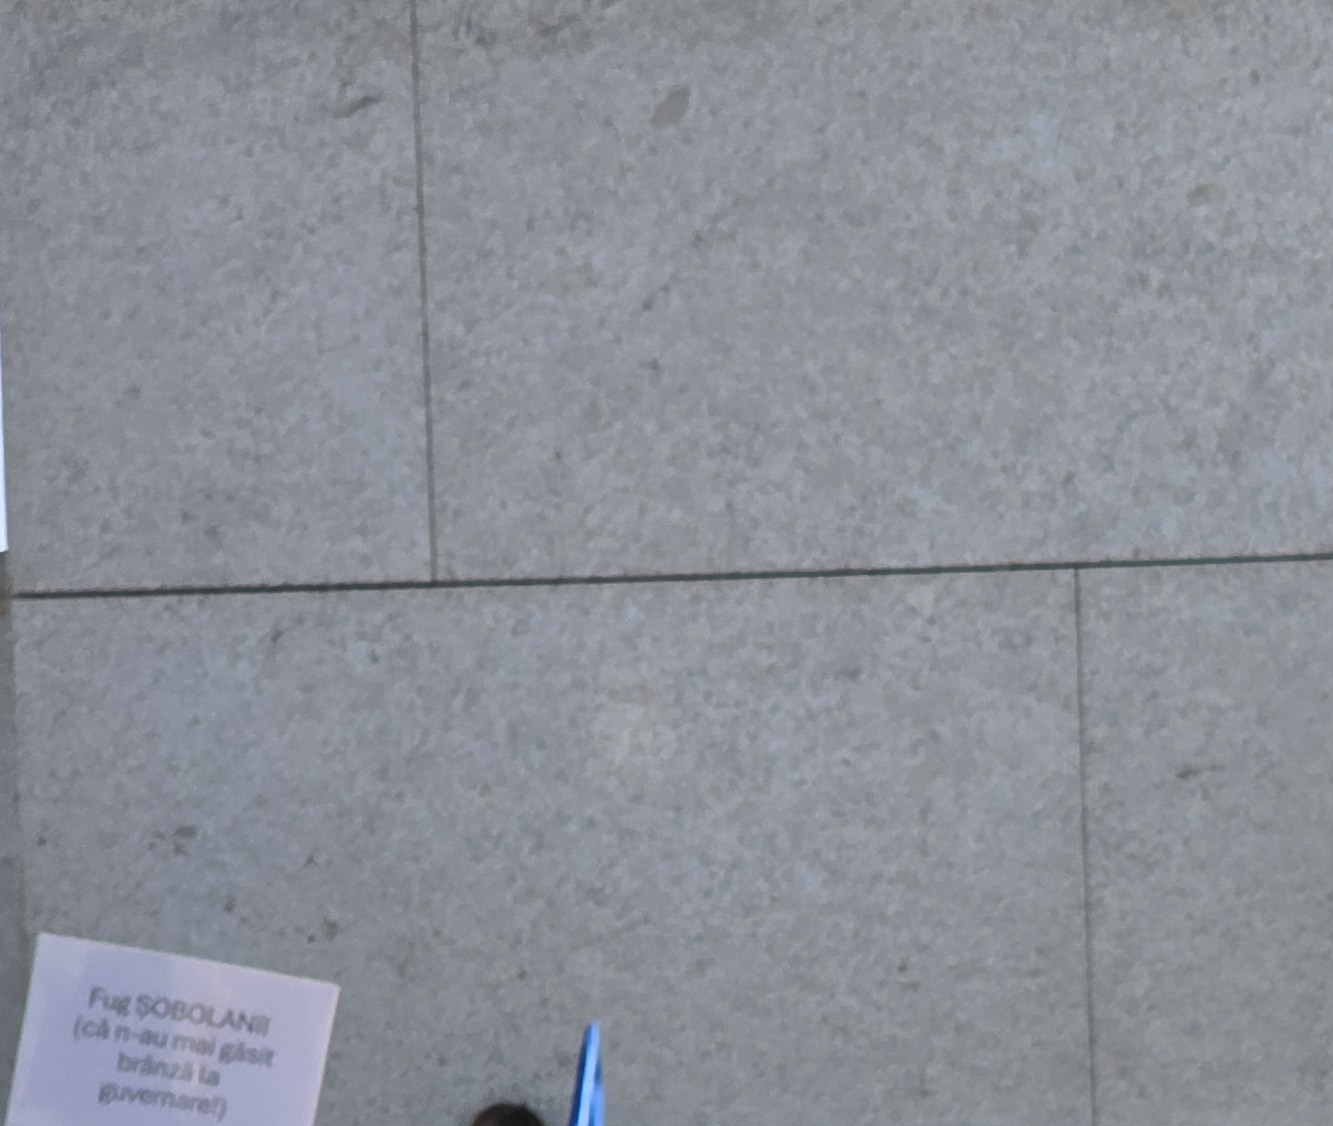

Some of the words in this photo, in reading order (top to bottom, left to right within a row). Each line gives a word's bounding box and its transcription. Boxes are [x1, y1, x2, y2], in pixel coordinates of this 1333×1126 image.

[89, 985, 132, 1016] Fug
[172, 1034, 217, 1056] mai
[198, 1063, 221, 1087] la
